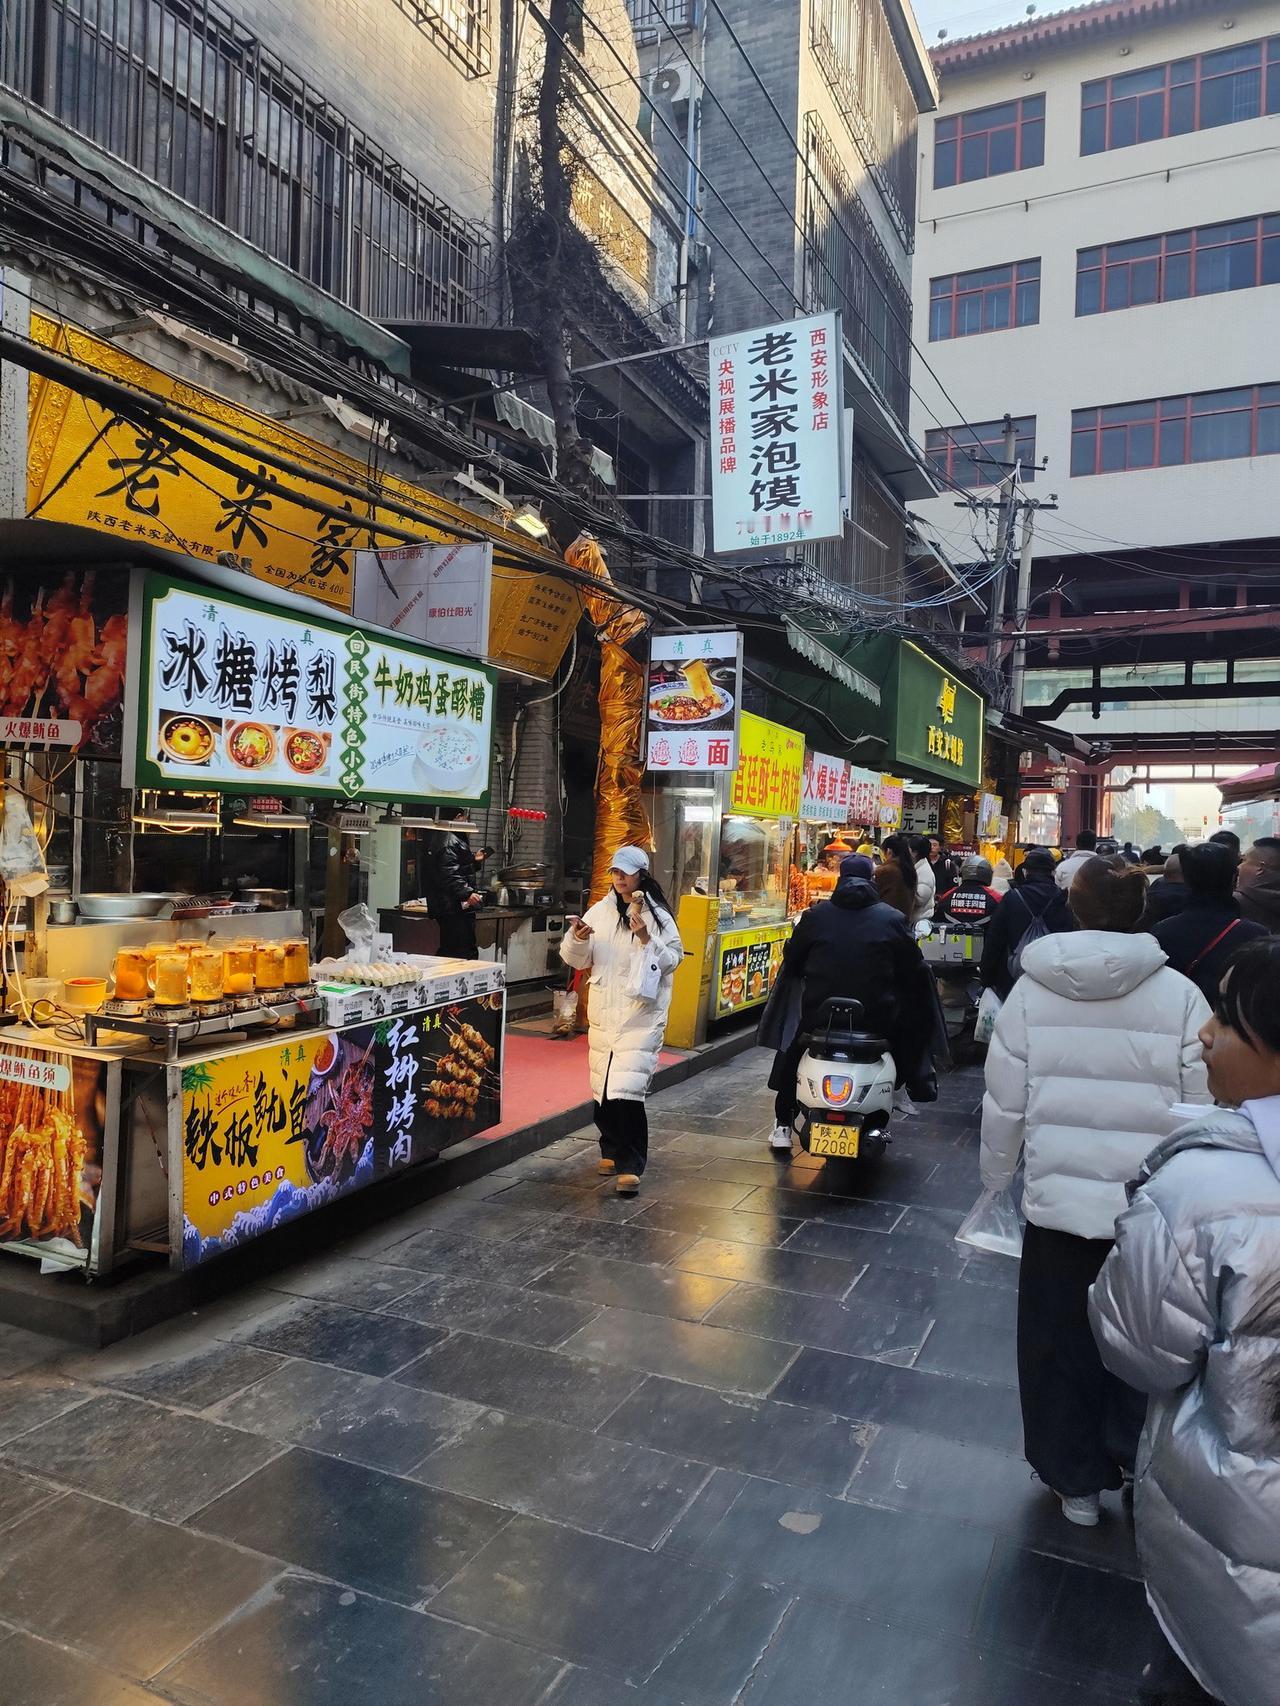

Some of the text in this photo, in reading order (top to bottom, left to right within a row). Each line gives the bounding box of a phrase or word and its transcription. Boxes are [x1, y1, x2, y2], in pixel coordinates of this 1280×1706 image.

[712, 341, 740, 358] CCTV
[809, 327, 829, 432] 西安形象店
[718, 358, 738, 474] 央视展播品牌
[748, 331, 802, 512] 老米家泡馍
[86, 509, 241, 563] 陕西老米家餐饮有限
[750, 531, 806, 546] 始于1892年
[161, 619, 338, 725] 冰糖烤梨
[373, 655, 486, 723] 牛奶鸡蛋醪糟
[5, 721, 60, 740] 火爆鱿鱼
[343, 639, 365, 790] 回民街特色小吃
[903, 812, 938, 832] 元一串
[280, 1044, 306, 1066] 清真
[185, 1069, 316, 1170] 铁板鱿鱼
[385, 1018, 419, 1168] 红柳烤肉
[813, 1138, 855, 1156] 7208C
[209, 1166, 285, 1205] 中式特色美食
